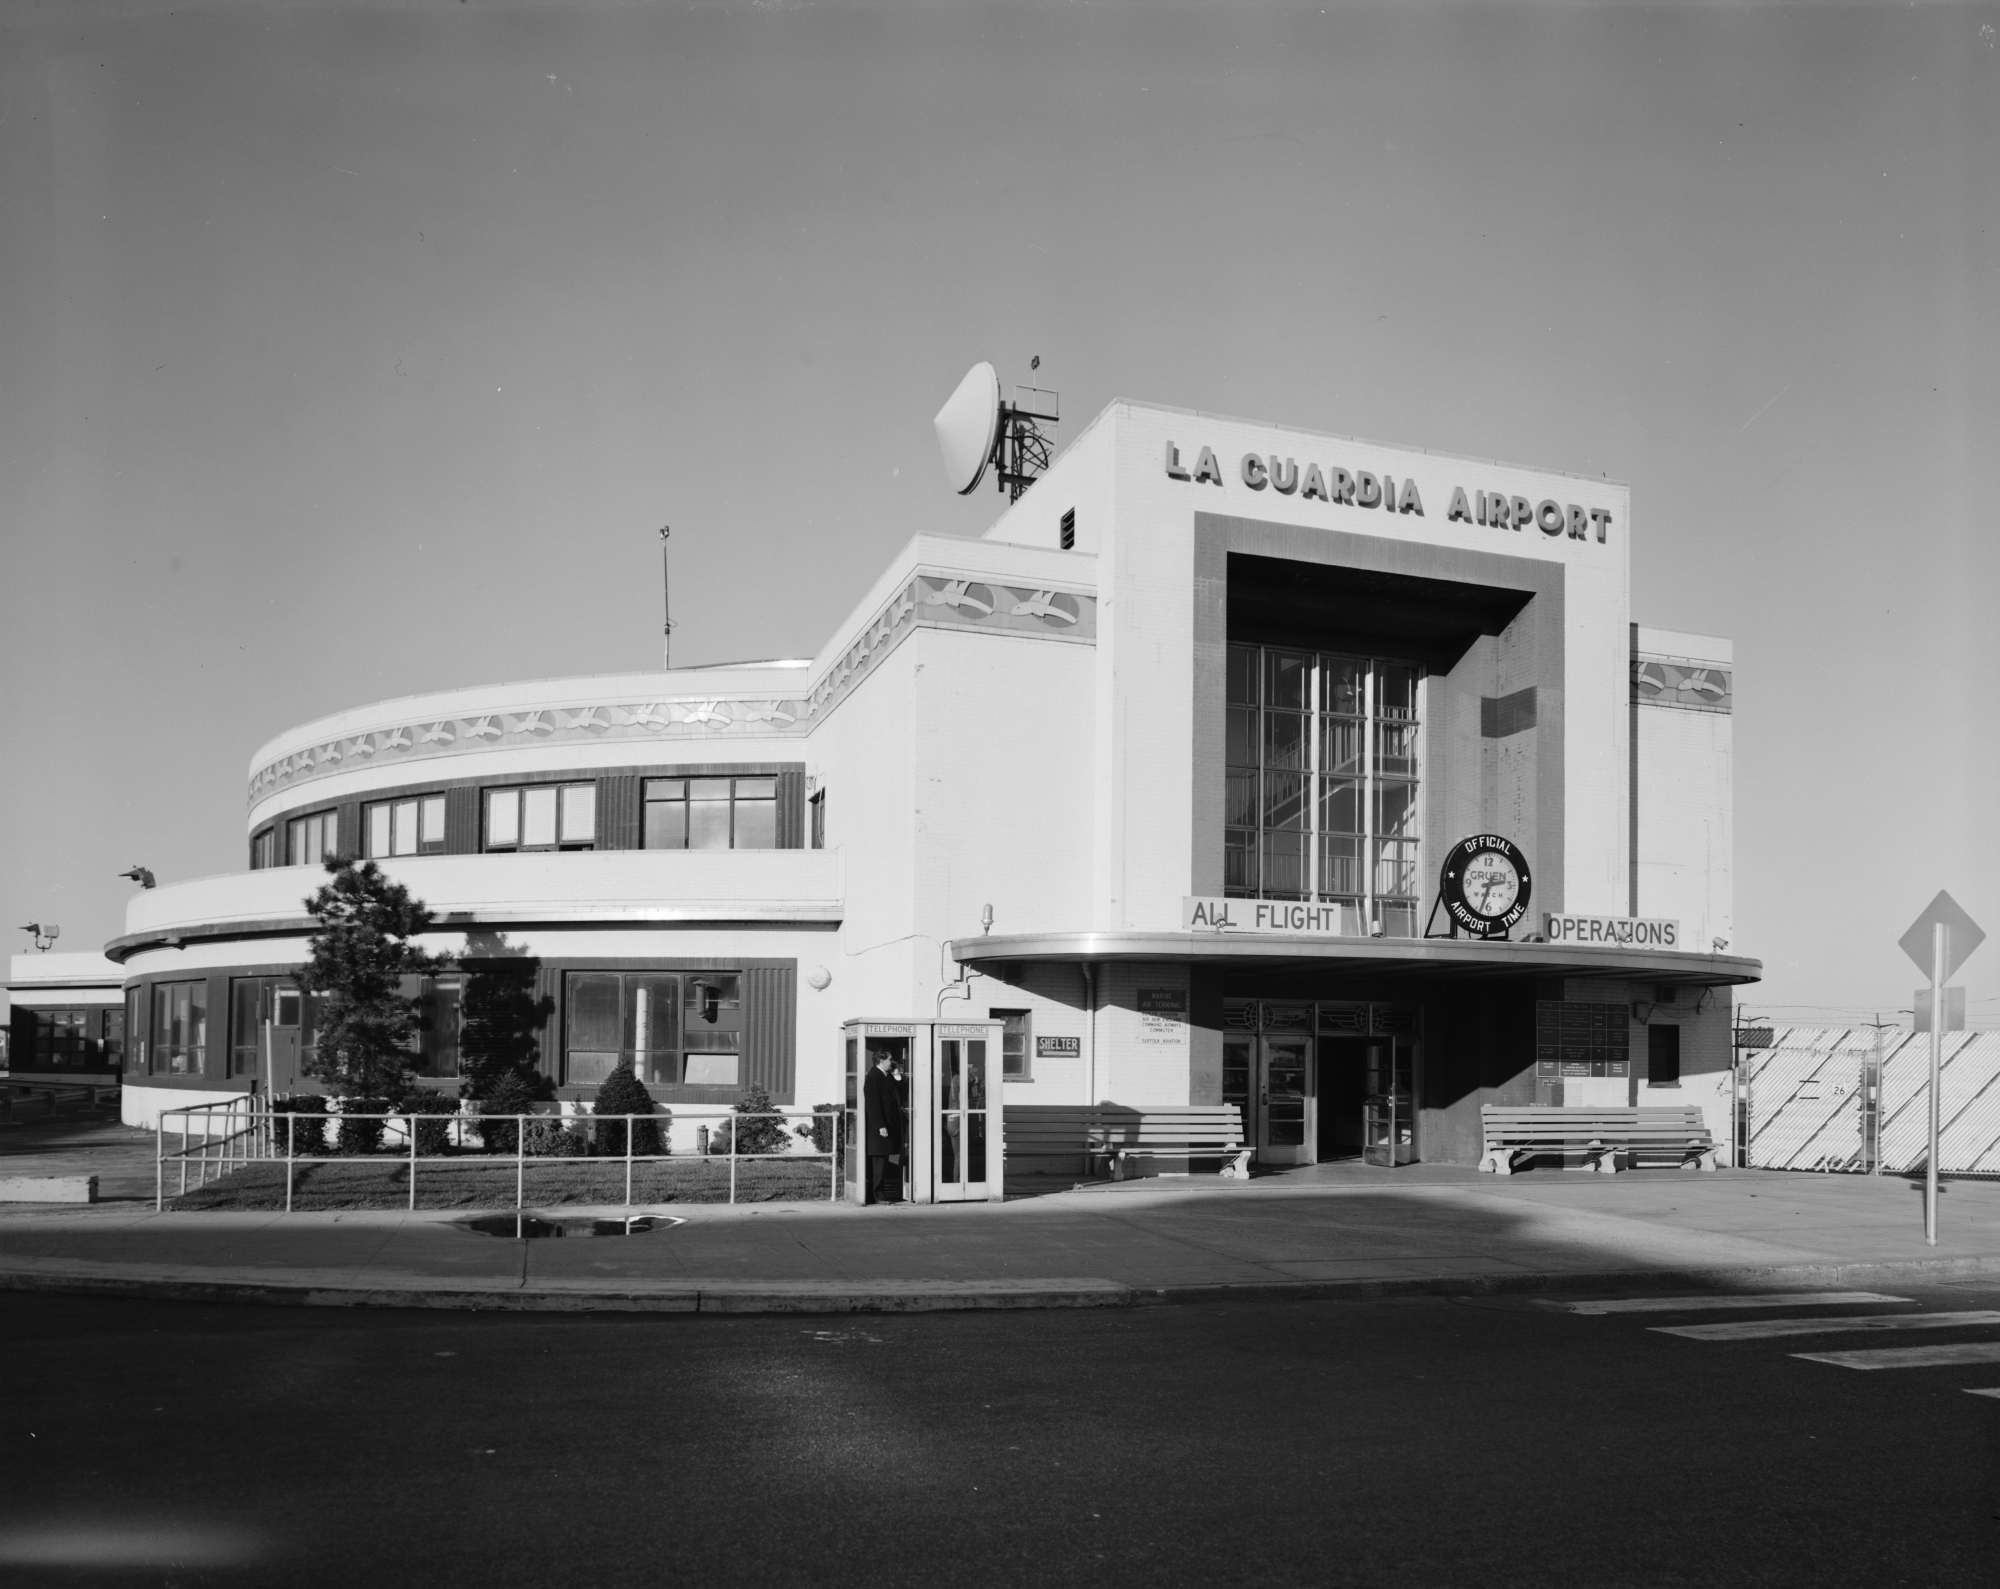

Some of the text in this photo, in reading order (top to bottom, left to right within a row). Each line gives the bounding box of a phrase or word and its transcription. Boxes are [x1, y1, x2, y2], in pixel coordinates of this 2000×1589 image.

[1166, 440, 1611, 542] LA GUARDIA AIRPORT
[1464, 836, 1511, 855] OFFICIAL
[1484, 857, 1494, 867] 12
[1470, 870, 1506, 881] GRUEN
[1465, 878, 1472, 888] 9
[1506, 881, 1513, 890] 3
[1485, 902, 1492, 912] 6
[1191, 902, 1334, 931] ALL FLIGHT
[1451, 901, 1525, 932] AIRPORT TIME
[1548, 917, 1676, 945] OPERATIONS
[1151, 992, 1173, 1000] MARINE
[1155, 1001, 1182, 1009] TERMINAL
[869, 1025, 912, 1034] TELEPHONE
[941, 1025, 985, 1034] TELEPHONE
[1039, 1037, 1078, 1050] SHELTER
[1834, 1086, 1845, 1095] 26
